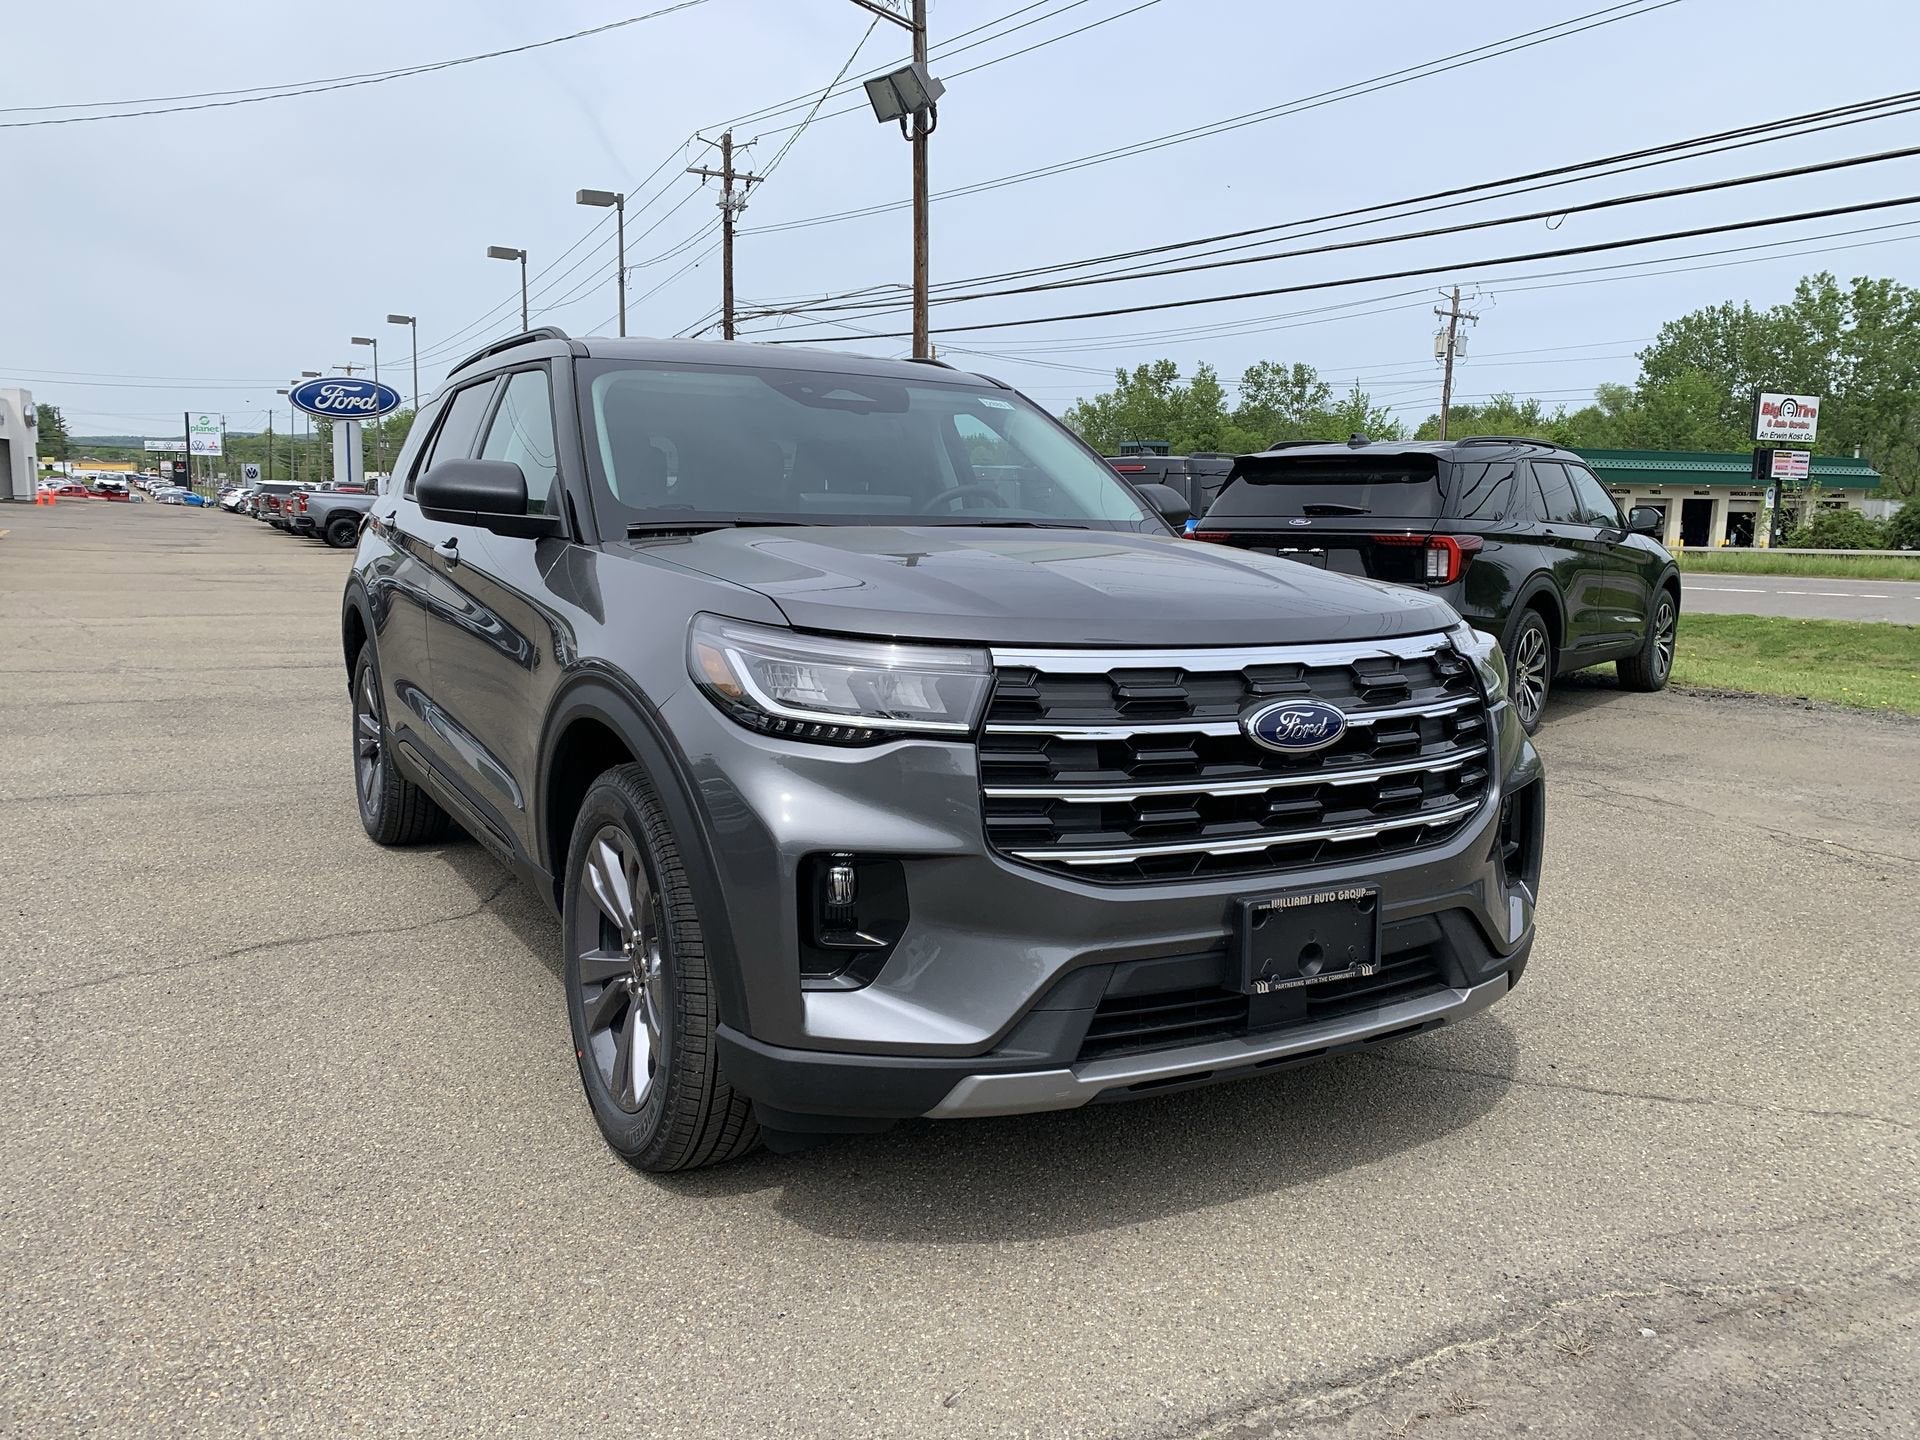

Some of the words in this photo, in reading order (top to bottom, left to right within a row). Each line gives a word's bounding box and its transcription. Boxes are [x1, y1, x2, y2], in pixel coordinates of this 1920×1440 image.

[314, 384, 376, 410] Ford
[1761, 402, 1780, 419] Big
[1797, 404, 1817, 418] Tire
[190, 425, 220, 433] planet
[1773, 420, 1787, 428] Auto
[1789, 421, 1809, 429] Service
[1770, 431, 1787, 439] Erwin
[1276, 711, 1328, 740] Ford
[1314, 892, 1336, 904] AUTO
[1275, 980, 1304, 990] PARTNERING
[1328, 971, 1356, 982] COMMUNITY
